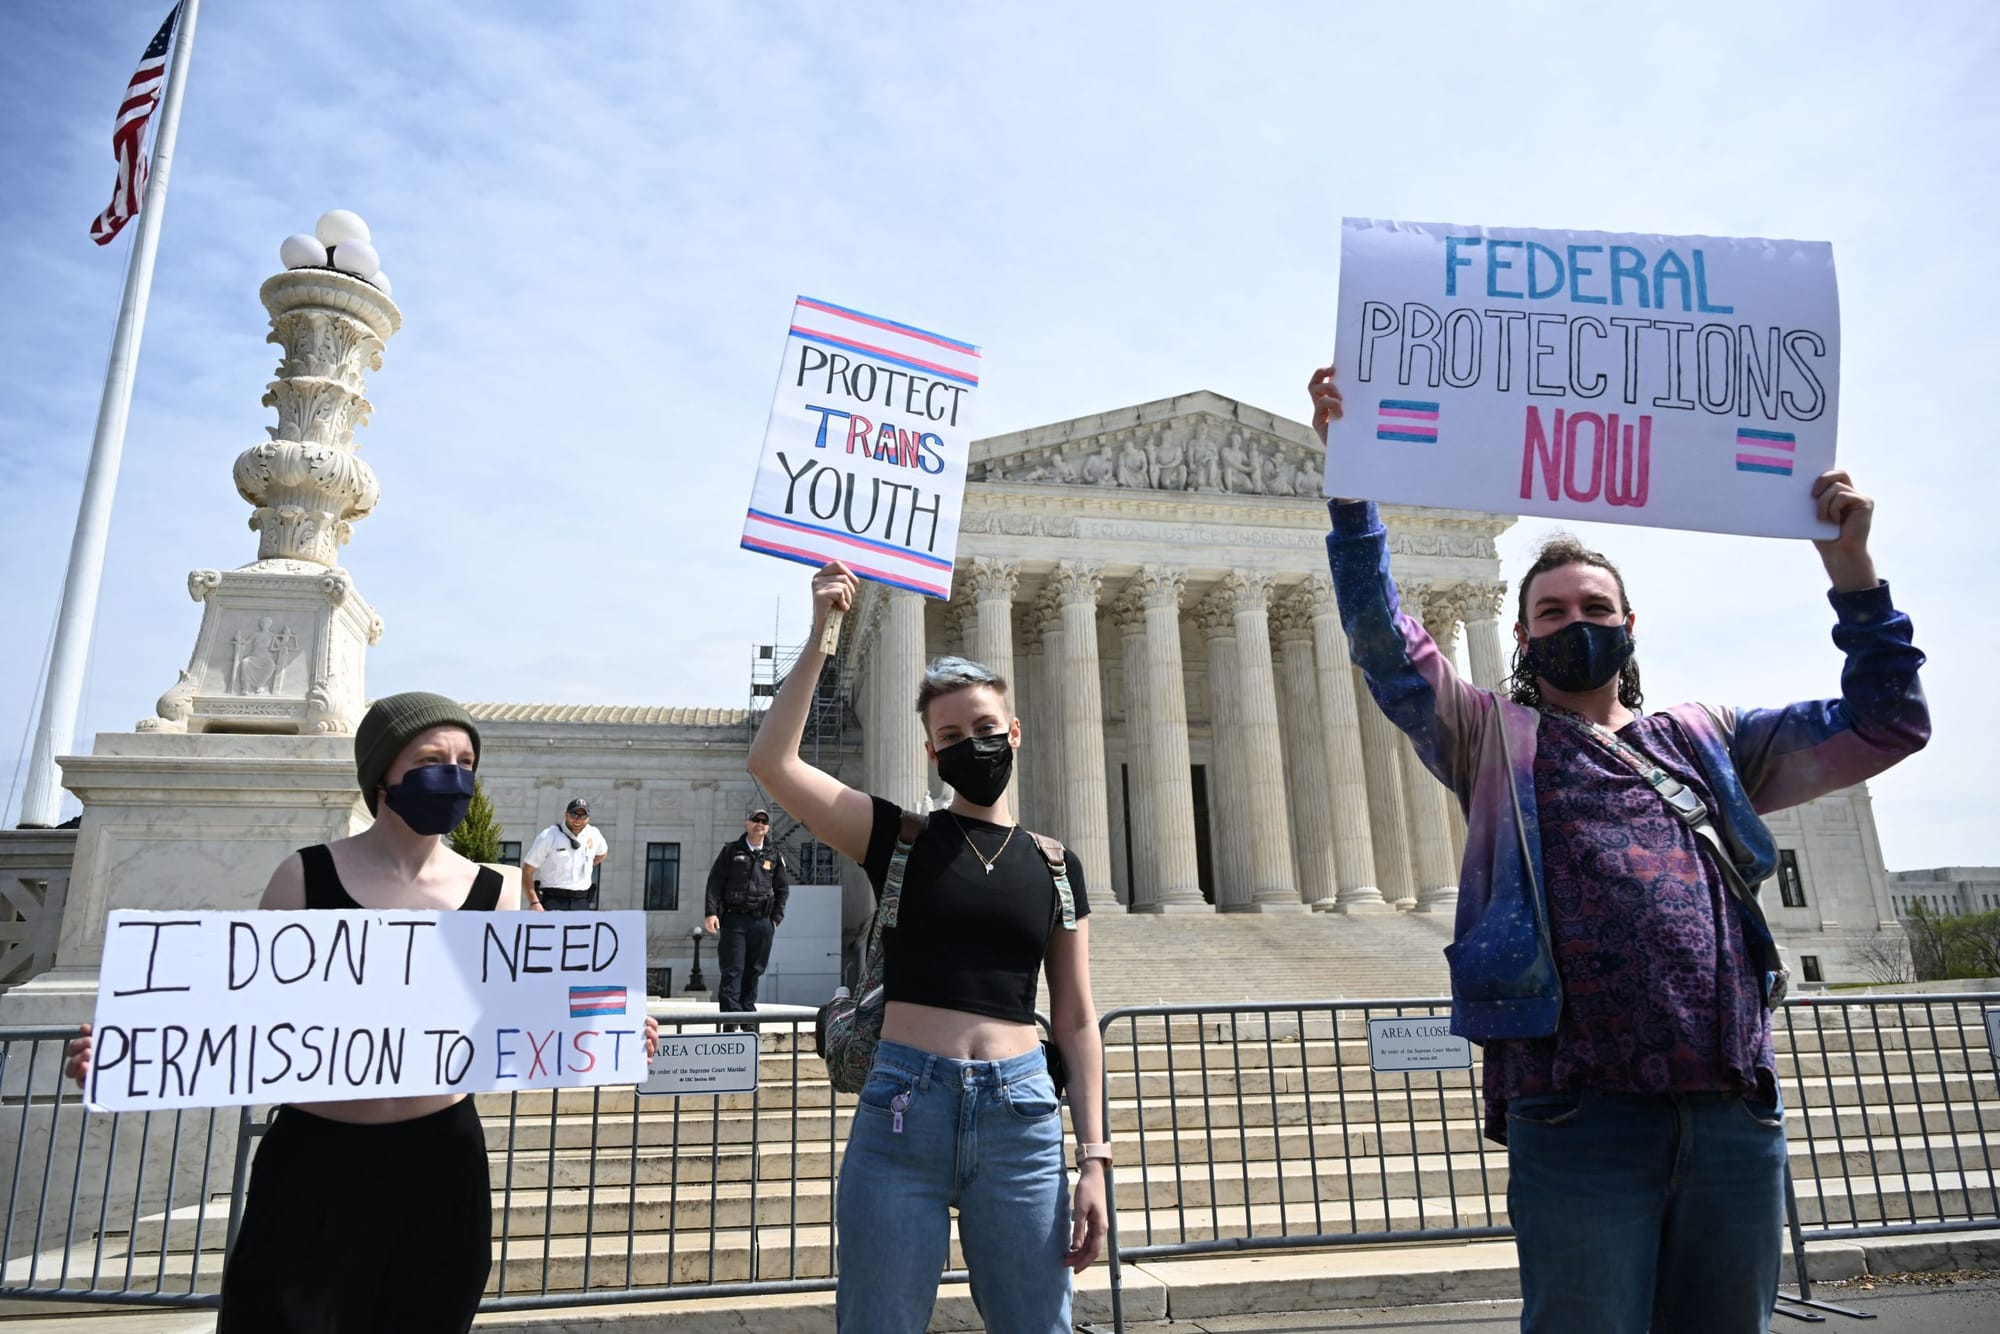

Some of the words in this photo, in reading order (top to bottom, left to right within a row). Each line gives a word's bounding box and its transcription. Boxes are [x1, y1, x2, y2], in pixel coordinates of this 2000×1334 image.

[1445, 236, 1734, 314] FEDERAL
[797, 345, 968, 427] PROTECT
[1358, 301, 1826, 421] PROTECTIONS
[805, 404, 945, 474] TRANS
[1519, 405, 1653, 508] NOW
[776, 452, 940, 552] YOUTH
[1091, 523, 1151, 540] EQUAL
[1154, 527, 1218, 543] JUSTICE
[1227, 530, 1280, 545] UNDER
[1287, 533, 1320, 546] LAW
[113, 920, 201, 996] I
[228, 918, 436, 991] DON'T
[482, 921, 619, 983] NEED
[90, 1022, 405, 1103] PERMISSION
[423, 1029, 475, 1085] TO
[496, 1028, 636, 1079] EXIST
[652, 1044, 689, 1057] AREA
[694, 1042, 745, 1056] CLOSED
[689, 1067, 710, 1075] Supreme
[1381, 1027, 1412, 1039] AREA
[1416, 1026, 1450, 1038] CLOSE
